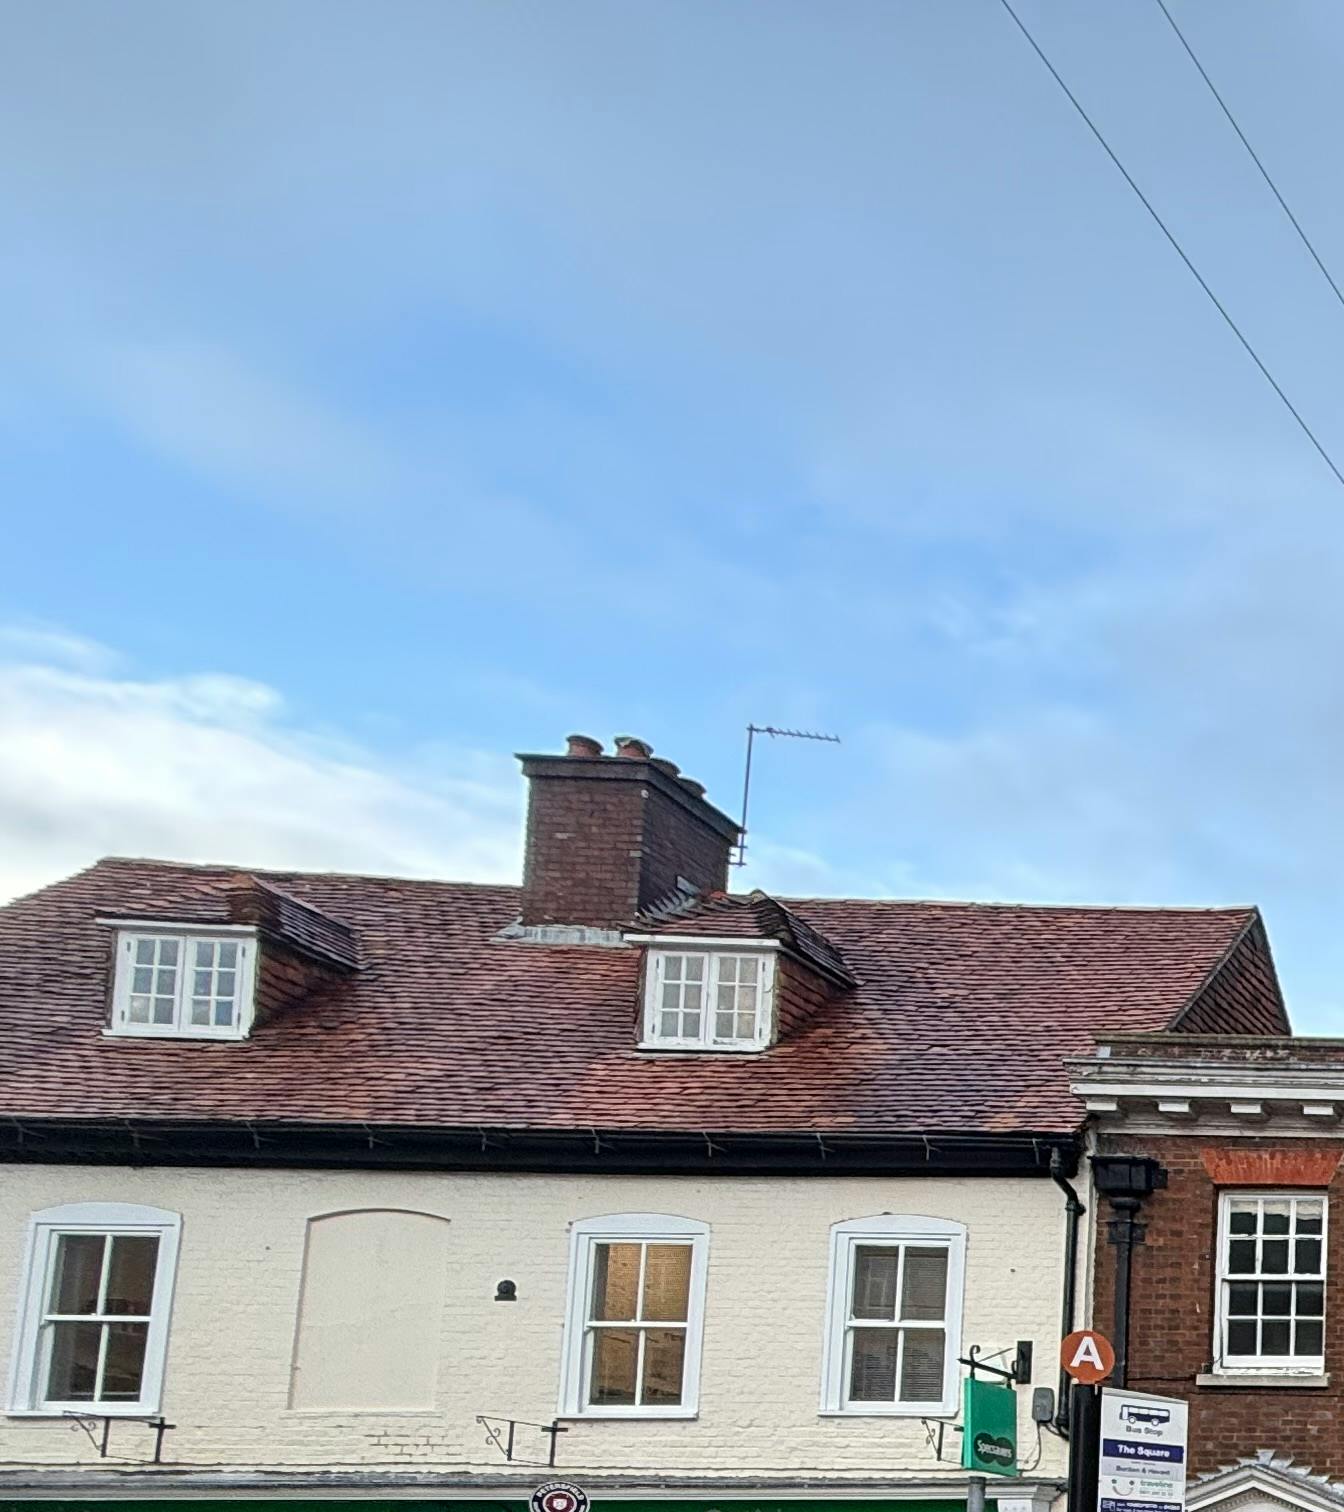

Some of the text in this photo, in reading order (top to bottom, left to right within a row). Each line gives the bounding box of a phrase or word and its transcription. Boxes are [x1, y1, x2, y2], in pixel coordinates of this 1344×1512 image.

[1070, 1336, 1104, 1370] A
[1117, 1444, 1171, 1458] The Square
